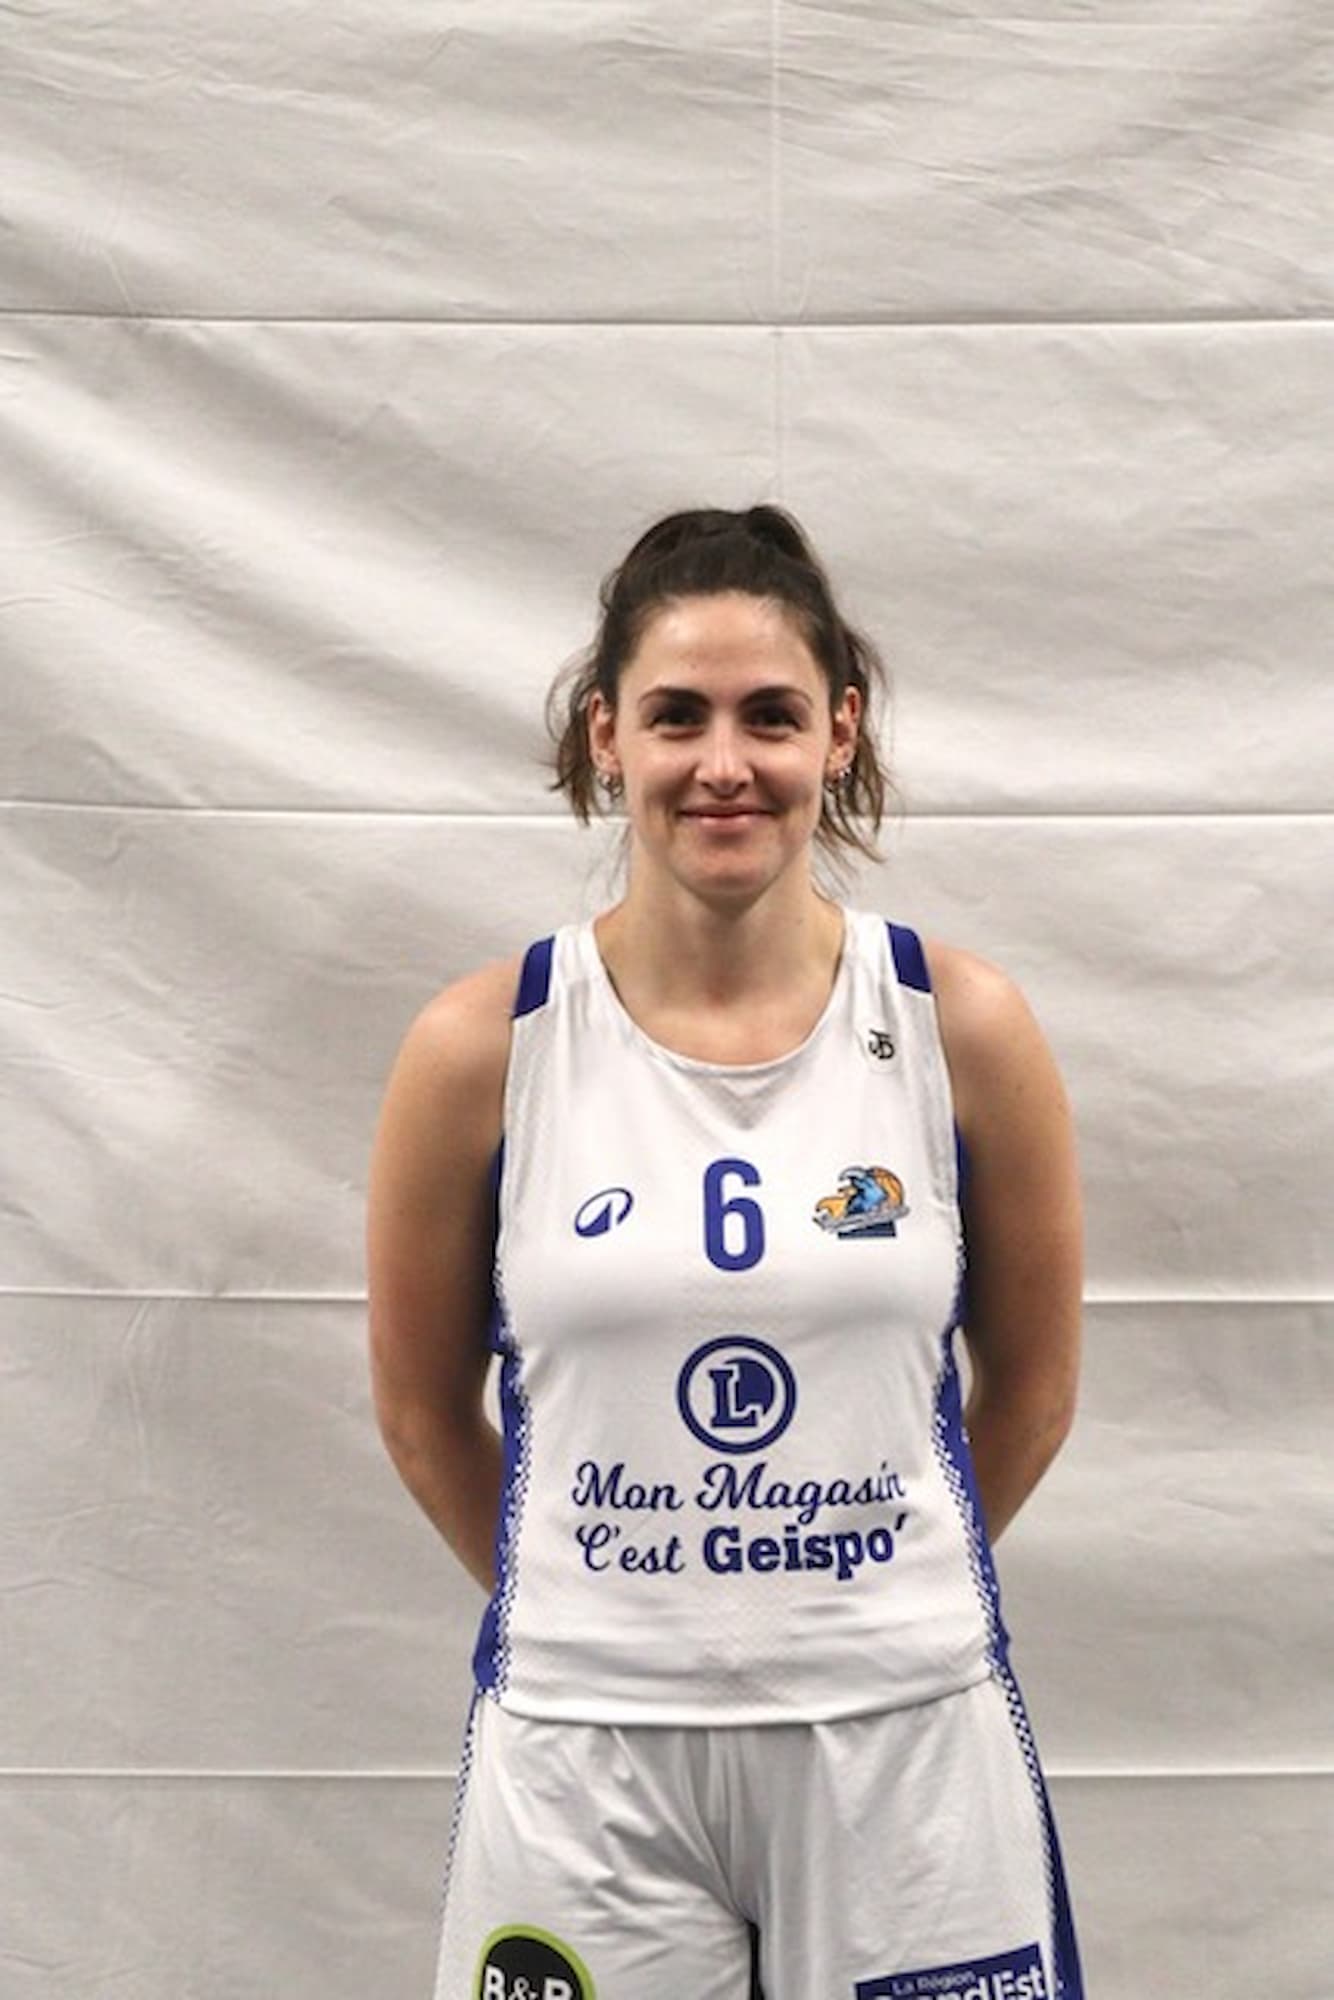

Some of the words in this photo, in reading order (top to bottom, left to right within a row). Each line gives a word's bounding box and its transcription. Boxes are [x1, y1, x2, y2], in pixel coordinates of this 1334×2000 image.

[703, 1159, 765, 1271] 6
[573, 1461, 683, 1510] Mon
[696, 1461, 905, 1525] Magasin
[576, 1524, 685, 1573] C'est
[703, 1513, 908, 1580] Geispo'
